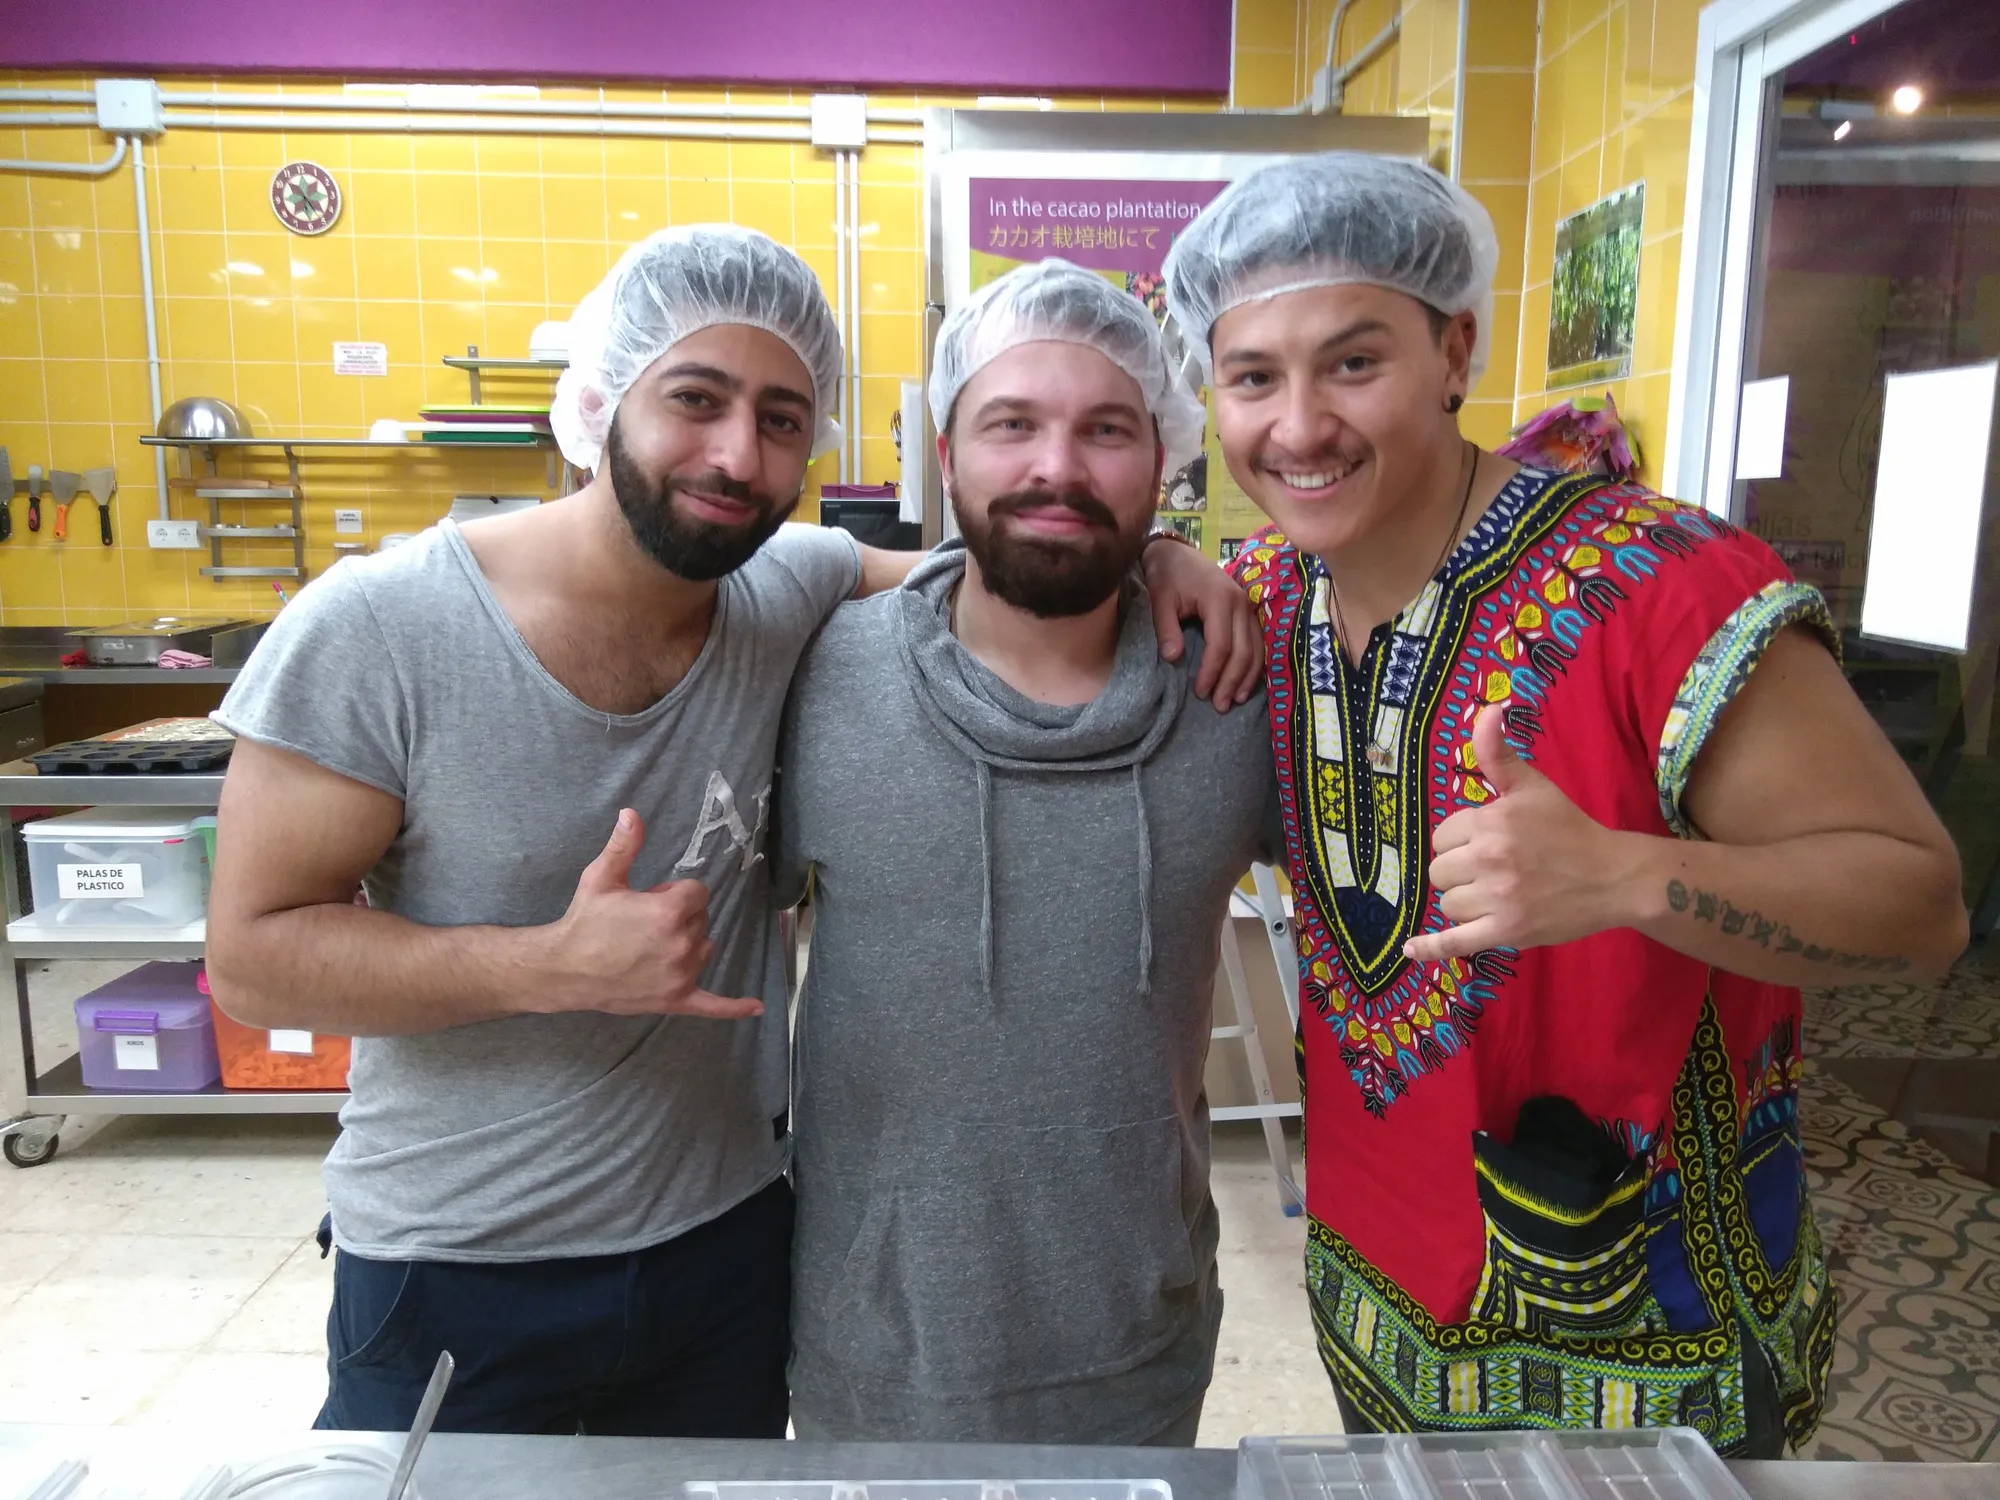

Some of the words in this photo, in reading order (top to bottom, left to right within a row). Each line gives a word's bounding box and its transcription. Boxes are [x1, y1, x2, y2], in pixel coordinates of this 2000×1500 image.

[989, 196, 1007, 217] In
[1012, 195, 1043, 217] the
[1047, 200, 1100, 218] cacao
[1106, 198, 1202, 222] plantation
[989, 223, 1160, 249] カカオ栽培地にて
[76, 869, 108, 878] PALAS
[109, 869, 123, 878] DE
[77, 881, 124, 891] PLASTICO
